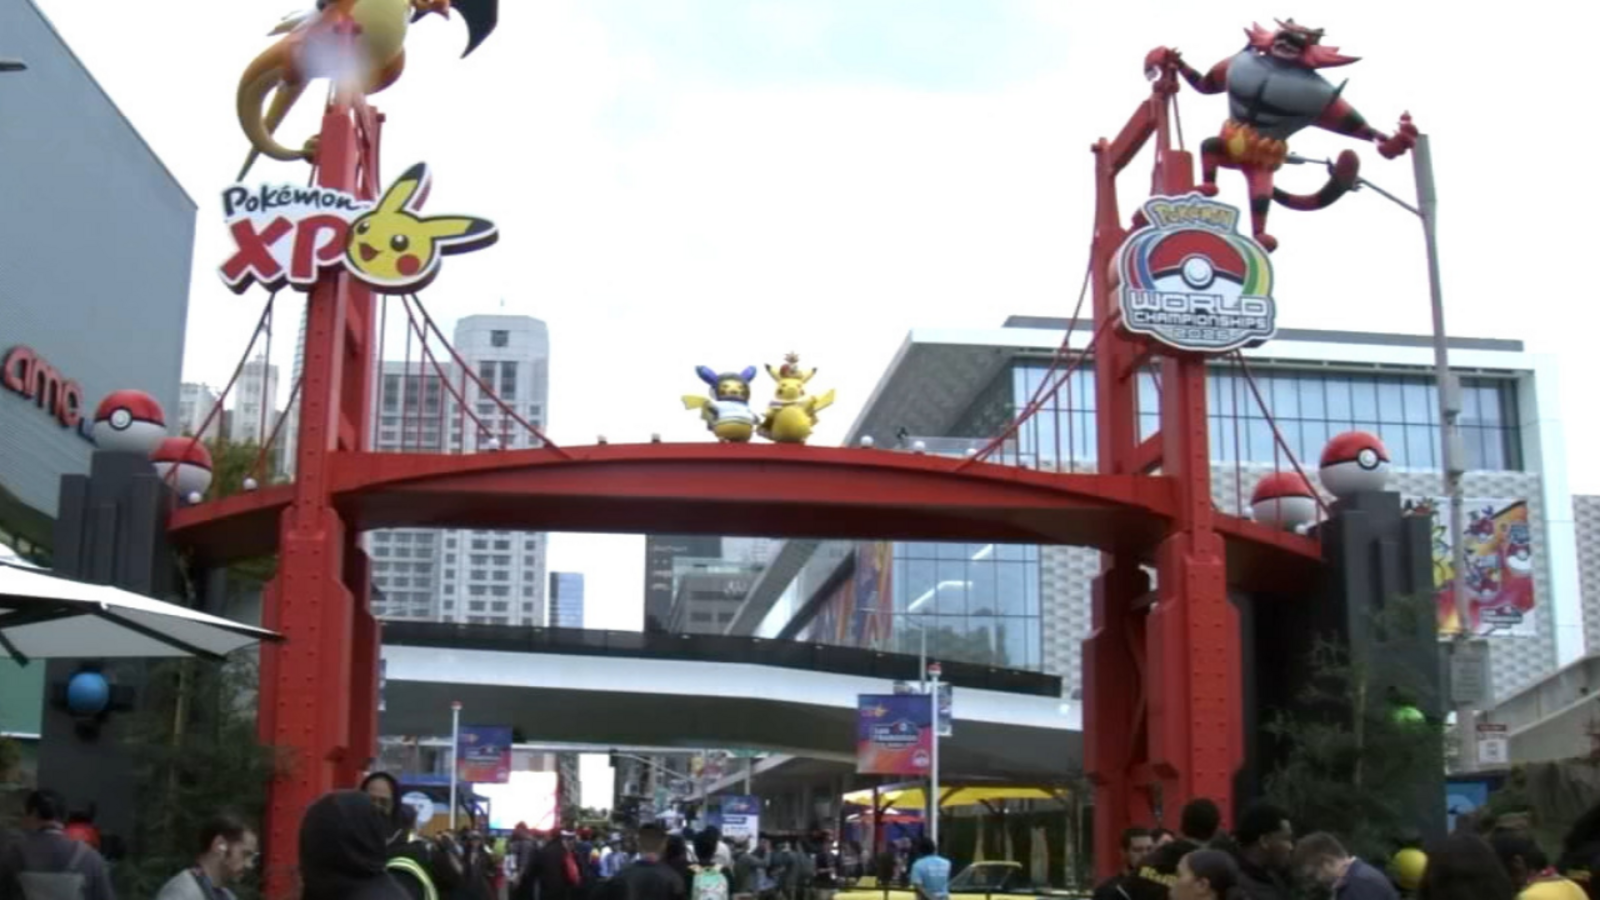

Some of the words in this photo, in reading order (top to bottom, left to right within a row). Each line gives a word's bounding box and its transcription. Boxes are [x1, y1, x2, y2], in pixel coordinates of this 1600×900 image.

[222, 184, 361, 217] Pokémon
[219, 214, 351, 281] XP
[1130, 291, 1268, 317] WORLD
[1134, 311, 1267, 329] CHAMPIONSHIPS
[3, 344, 83, 427] amc
